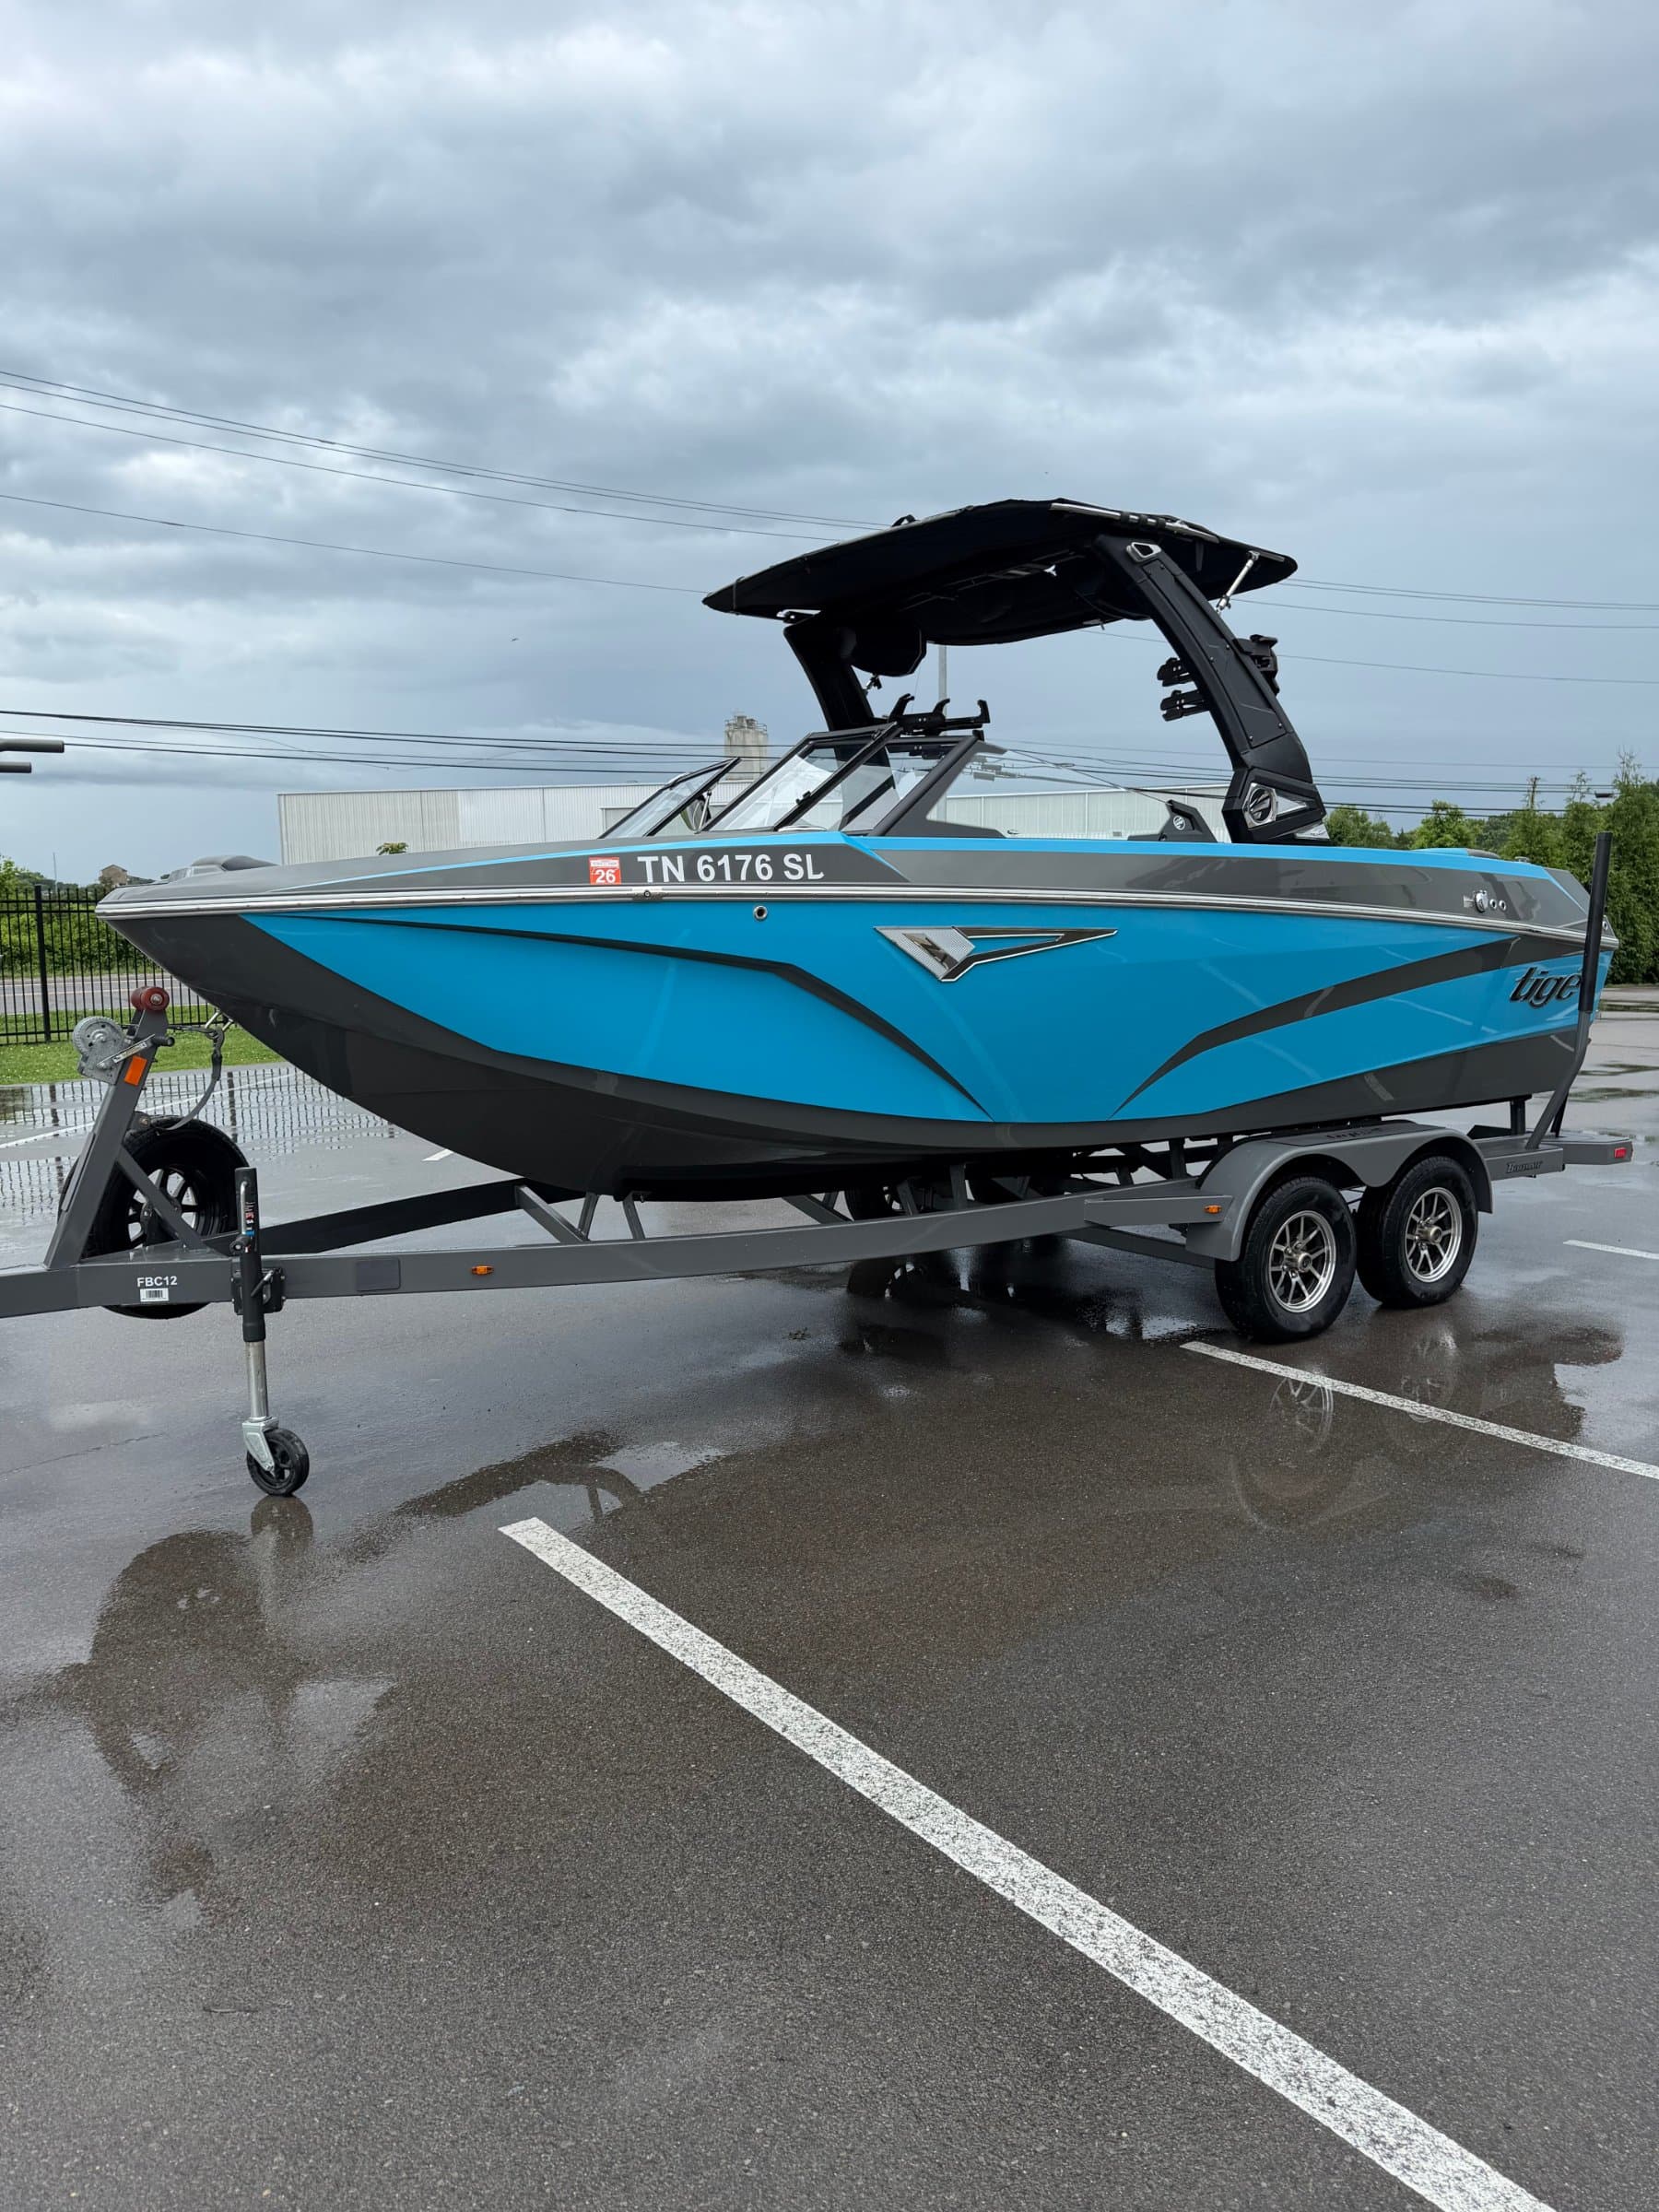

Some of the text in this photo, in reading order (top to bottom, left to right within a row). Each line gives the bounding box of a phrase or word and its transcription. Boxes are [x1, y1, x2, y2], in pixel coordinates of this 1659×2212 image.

[594, 868, 617, 884] 26
[637, 853, 825, 883] TN 6176 SL
[136, 1275, 178, 1288] FBC12
